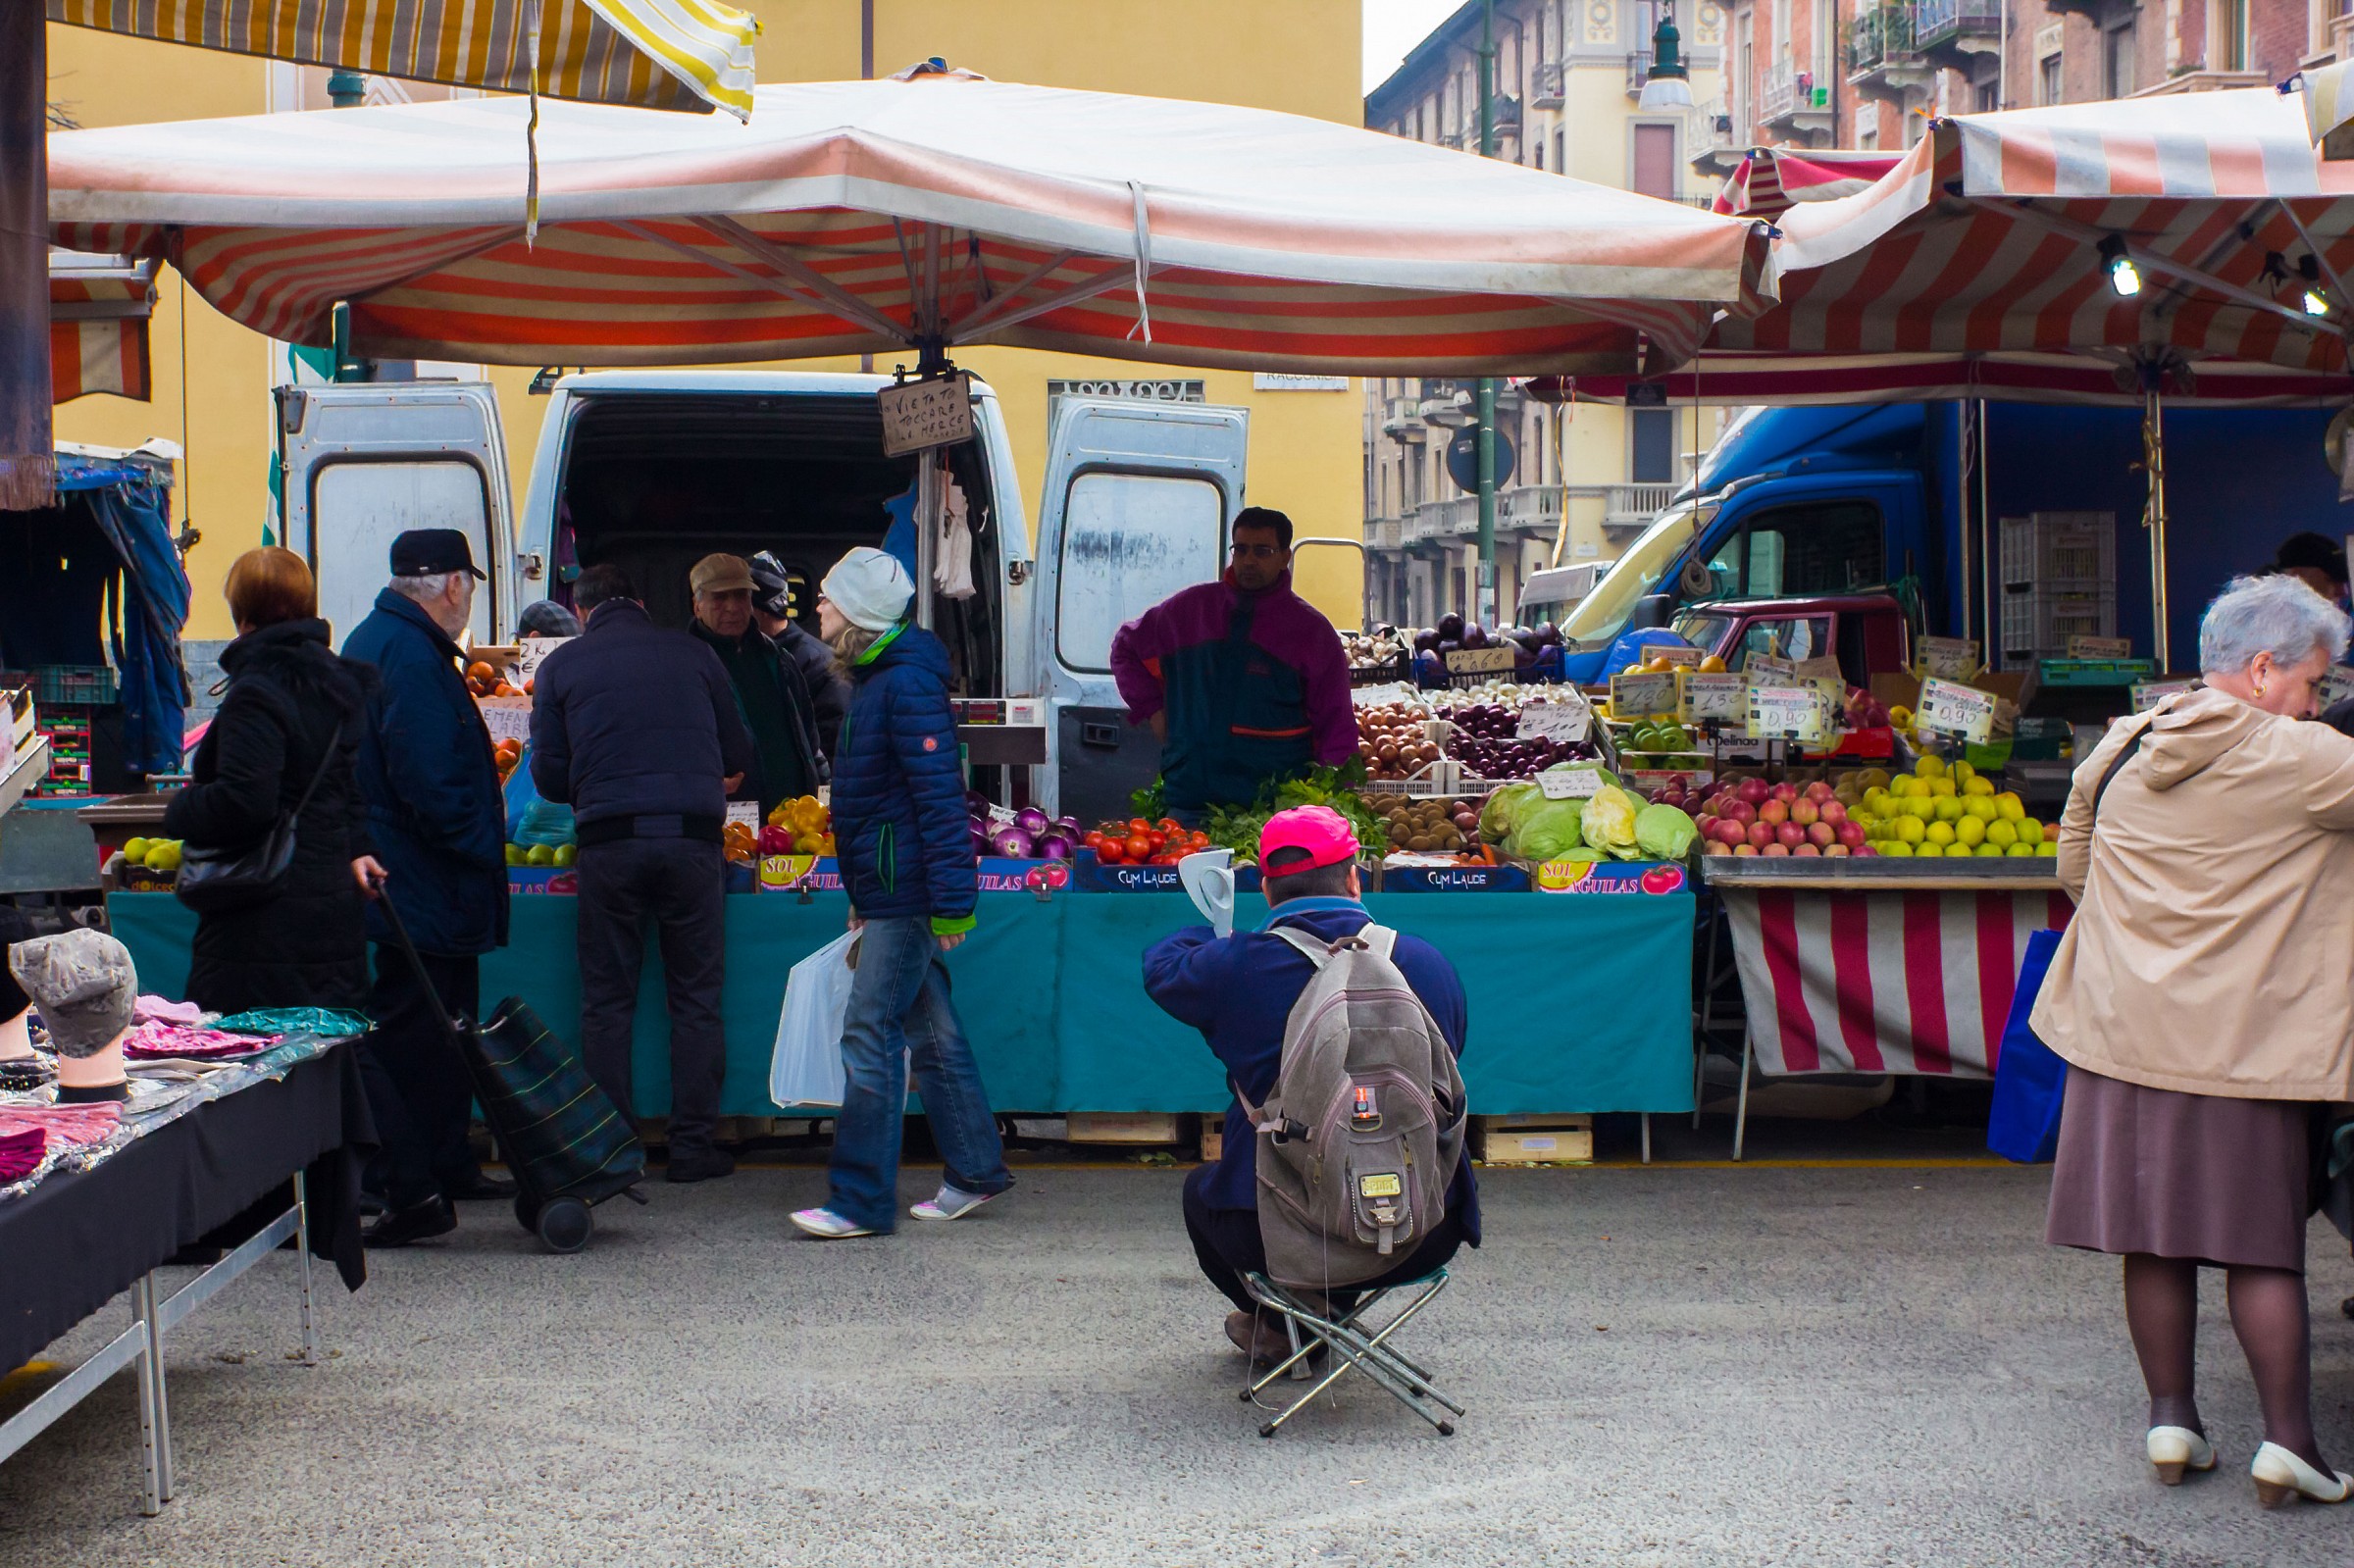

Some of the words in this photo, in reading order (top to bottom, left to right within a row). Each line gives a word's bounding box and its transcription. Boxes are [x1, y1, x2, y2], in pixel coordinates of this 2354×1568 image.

[899, 403, 955, 426] TOCCARE
[521, 642, 530, 658] 2
[1767, 711, 1807, 729] 0,90
[1939, 706, 1977, 725] 0,90
[765, 858, 797, 874] SOL
[1543, 864, 1574, 879] SOL
[1570, 879, 1638, 893] AGUILAS
